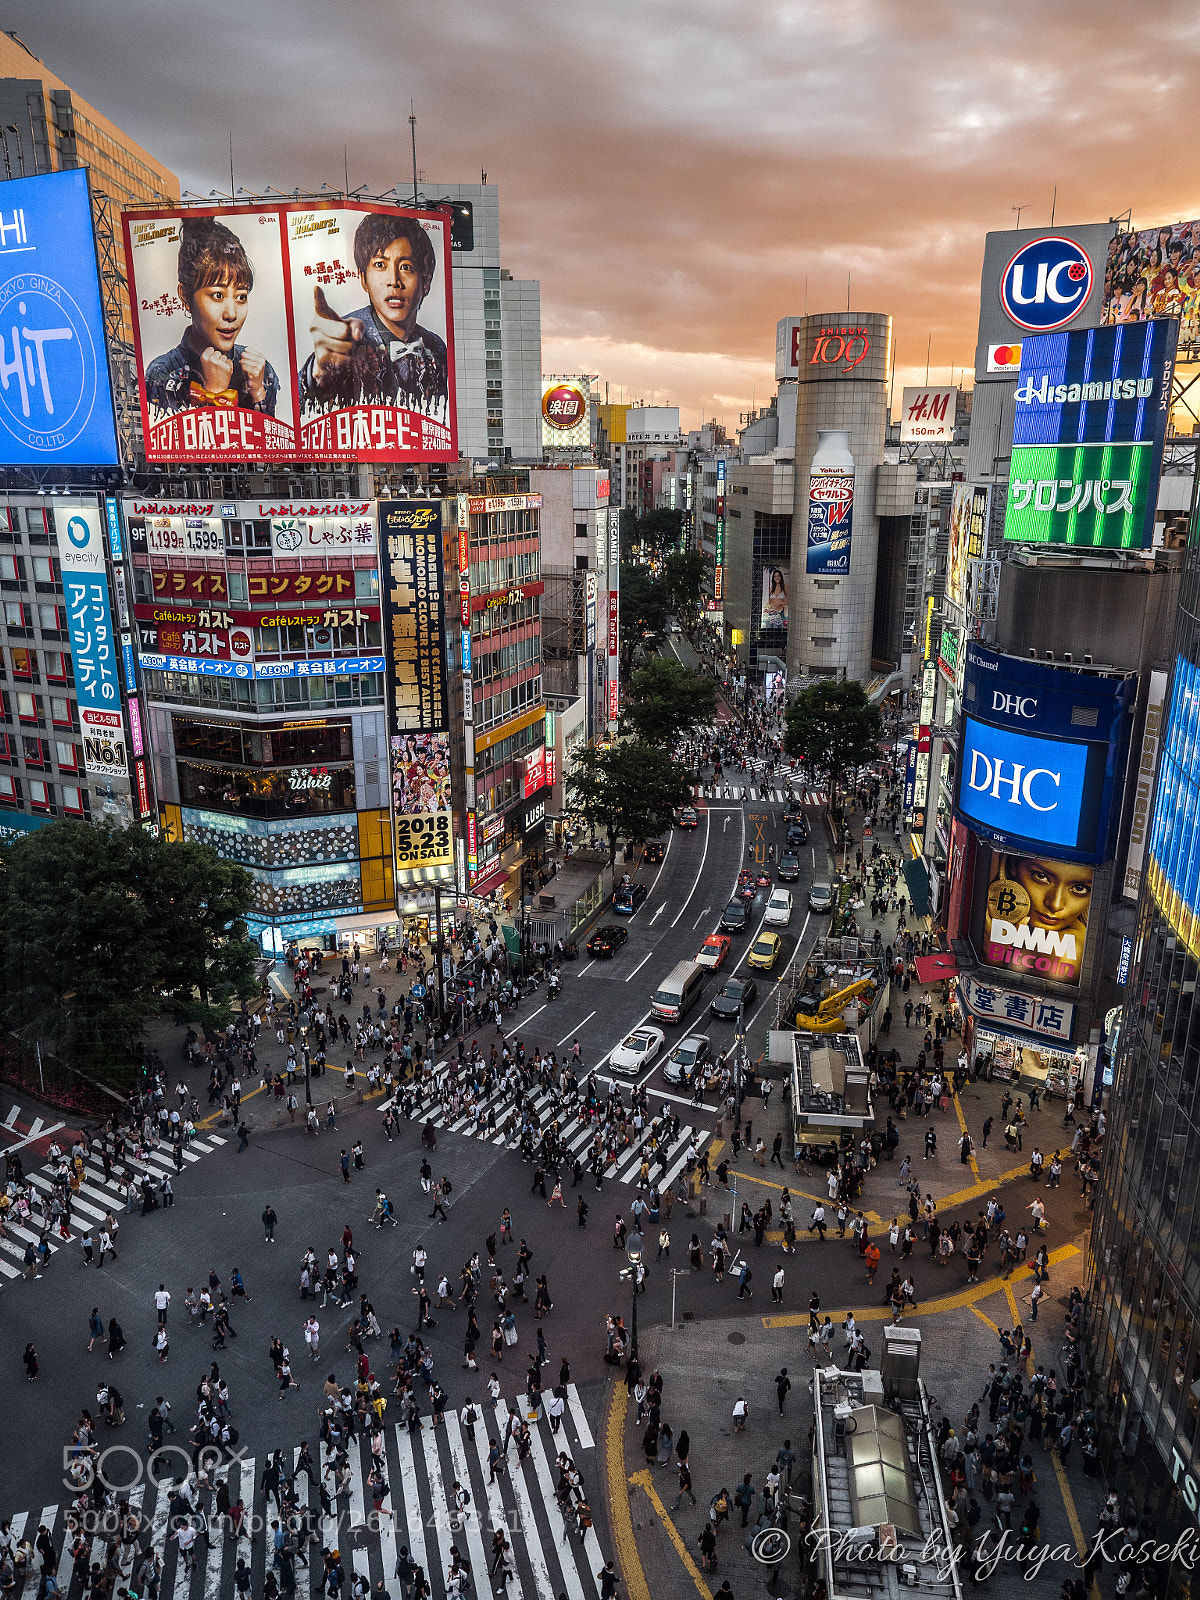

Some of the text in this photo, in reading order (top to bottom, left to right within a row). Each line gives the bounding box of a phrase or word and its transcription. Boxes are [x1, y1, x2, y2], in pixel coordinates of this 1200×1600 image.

[29, 277, 62, 302] GINZA
[820, 327, 868, 335] SHIBUYA
[808, 335, 870, 373] 109
[1013, 374, 1153, 405] Hisamitsu
[1159, 360, 1172, 411] サロンパス
[550, 400, 579, 415] 楽園
[908, 393, 951, 422] H&M
[182, 410, 262, 450] 日本ダービー
[336, 409, 419, 450] 日本ダービー
[816, 490, 846, 499] ヤクルト
[1011, 479, 1133, 514] サロンパス
[133, 502, 214, 516] しゃぶしゃぶバイキング
[258, 503, 370, 517] しゃぶしゃぶバイキング
[828, 500, 854, 526] W
[131, 528, 146, 540] 9F
[308, 522, 373, 545] しゃぶ葉
[65, 552, 99, 567] eyecity
[415, 535, 427, 599] MOMOIRO
[153, 572, 226, 594] プライス
[249, 574, 351, 595] コンタクト
[323, 608, 370, 628] ガスト
[418, 601, 428, 647] CLOVER
[68, 583, 99, 699] アイシティ
[90, 584, 116, 700] コンタクトの
[141, 629, 157, 643] 7F
[182, 630, 226, 655] ガスト
[169, 658, 233, 675] 英会話イーオン
[260, 660, 383, 677] AEON 英会話イーオン
[420, 659, 430, 687] BEST
[977, 656, 999, 672] Channel
[421, 688, 432, 728] ALBUM
[992, 690, 1037, 718] DHC
[84, 737, 126, 767] No.1
[968, 748, 1061, 812] DHC
[397, 816, 449, 835] 2018
[525, 801, 545, 828] LUSH
[398, 831, 449, 852] 5.23
[993, 833, 1007, 843] DHC
[399, 847, 450, 861] ON SALE
[990, 918, 1078, 961] DMM
[988, 943, 1076, 978] Bitcoin
